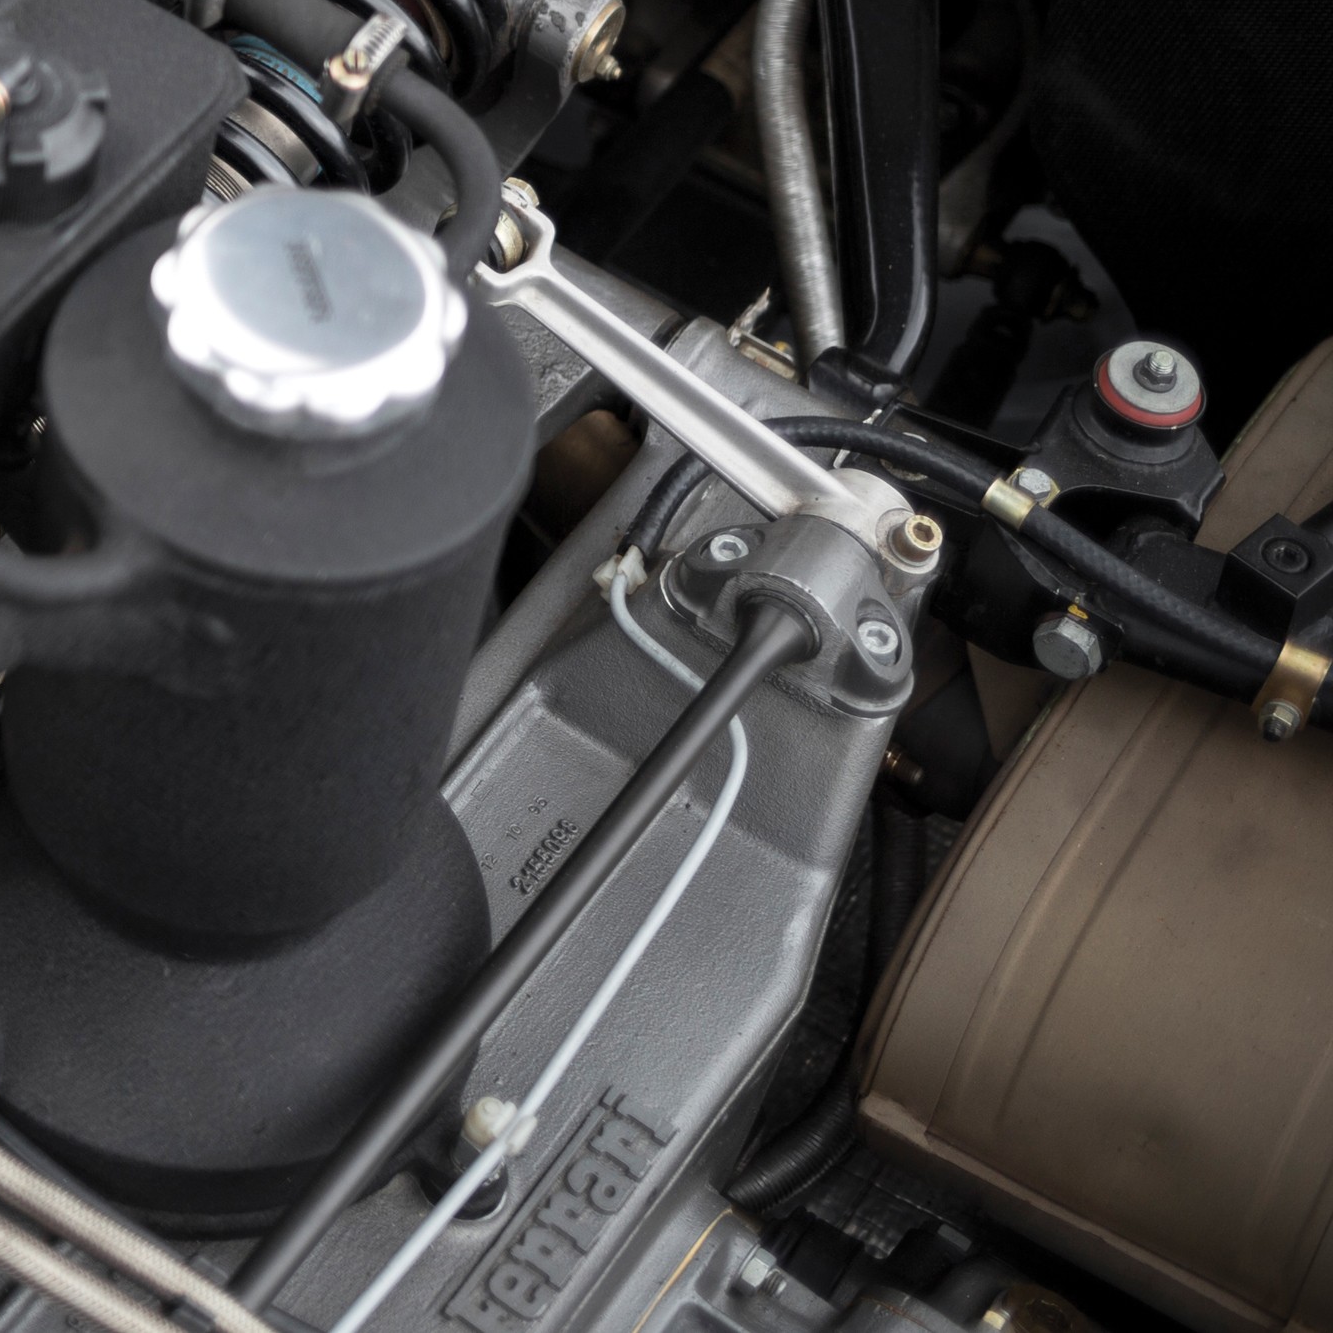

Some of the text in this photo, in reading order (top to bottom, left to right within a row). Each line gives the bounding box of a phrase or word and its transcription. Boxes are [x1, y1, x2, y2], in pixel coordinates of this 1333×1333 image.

[480, 795, 548, 870] 12 10 95
[440, 1085, 680, 1333] Ferrari
